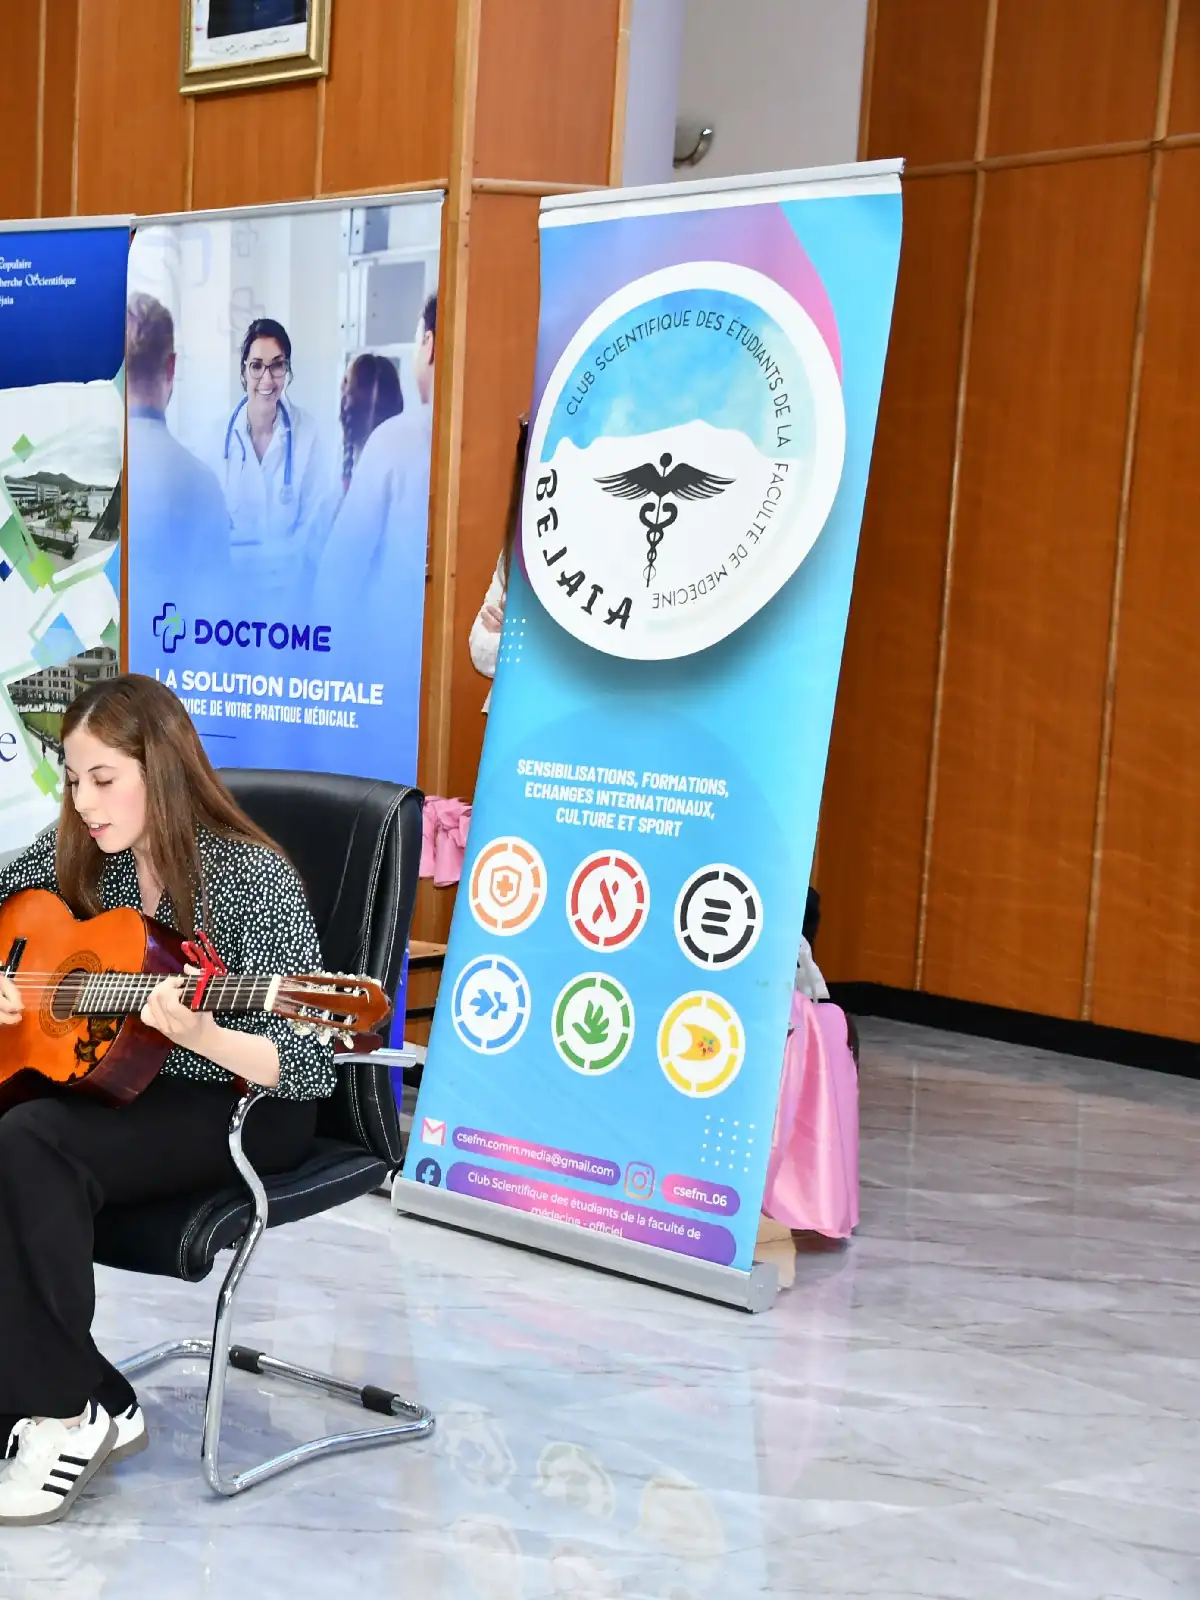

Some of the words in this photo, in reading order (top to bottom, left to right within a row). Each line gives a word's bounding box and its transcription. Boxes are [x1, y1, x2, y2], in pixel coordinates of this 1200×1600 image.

[25, 273, 76, 287] Scientifique
[696, 310, 725, 331] DES
[595, 310, 692, 371] SCIENTIFIQUE
[726, 316, 783, 391] ÉTUDIANTS
[566, 371, 596, 415] CLUB
[773, 393, 791, 418] DE
[777, 424, 792, 448] LA
[745, 462, 789, 545] FACULTÉ
[535, 468, 633, 630] BEJAIA
[728, 544, 748, 569] DE
[194, 619, 332, 652] DOCTOME
[156, 668, 177, 689] LA
[182, 670, 283, 697] SOLUTION
[289, 677, 384, 706] DIGITALE
[179, 697, 207, 715] VICE
[210, 699, 222, 716] DE
[225, 700, 252, 719] VOTRE
[254, 703, 302, 724] PRATIQUE
[304, 705, 359, 729] MÉDICALE.
[516, 759, 639, 789] SENSIBILISATIONS,
[641, 771, 729, 798] FORMATIONS,
[525, 781, 594, 805] ECHANGES
[596, 790, 715, 821] INTERNATIONAUX,
[556, 807, 614, 829] CULTURE
[618, 815, 637, 832] ET
[638, 817, 683, 837] SPORT
[457, 1132, 614, 1178] csefm.comm.media@gmail.com
[467, 1171, 490, 1187] Club
[492, 1177, 549, 1201] Scientifique
[550, 1192, 569, 1207] des
[570, 1196, 618, 1219] étudiants
[621, 1211, 634, 1223] de
[636, 1214, 646, 1226] la
[648, 1217, 685, 1236] faculté
[687, 1228, 701, 1240] de
[673, 1185, 728, 1207] csefm_06
